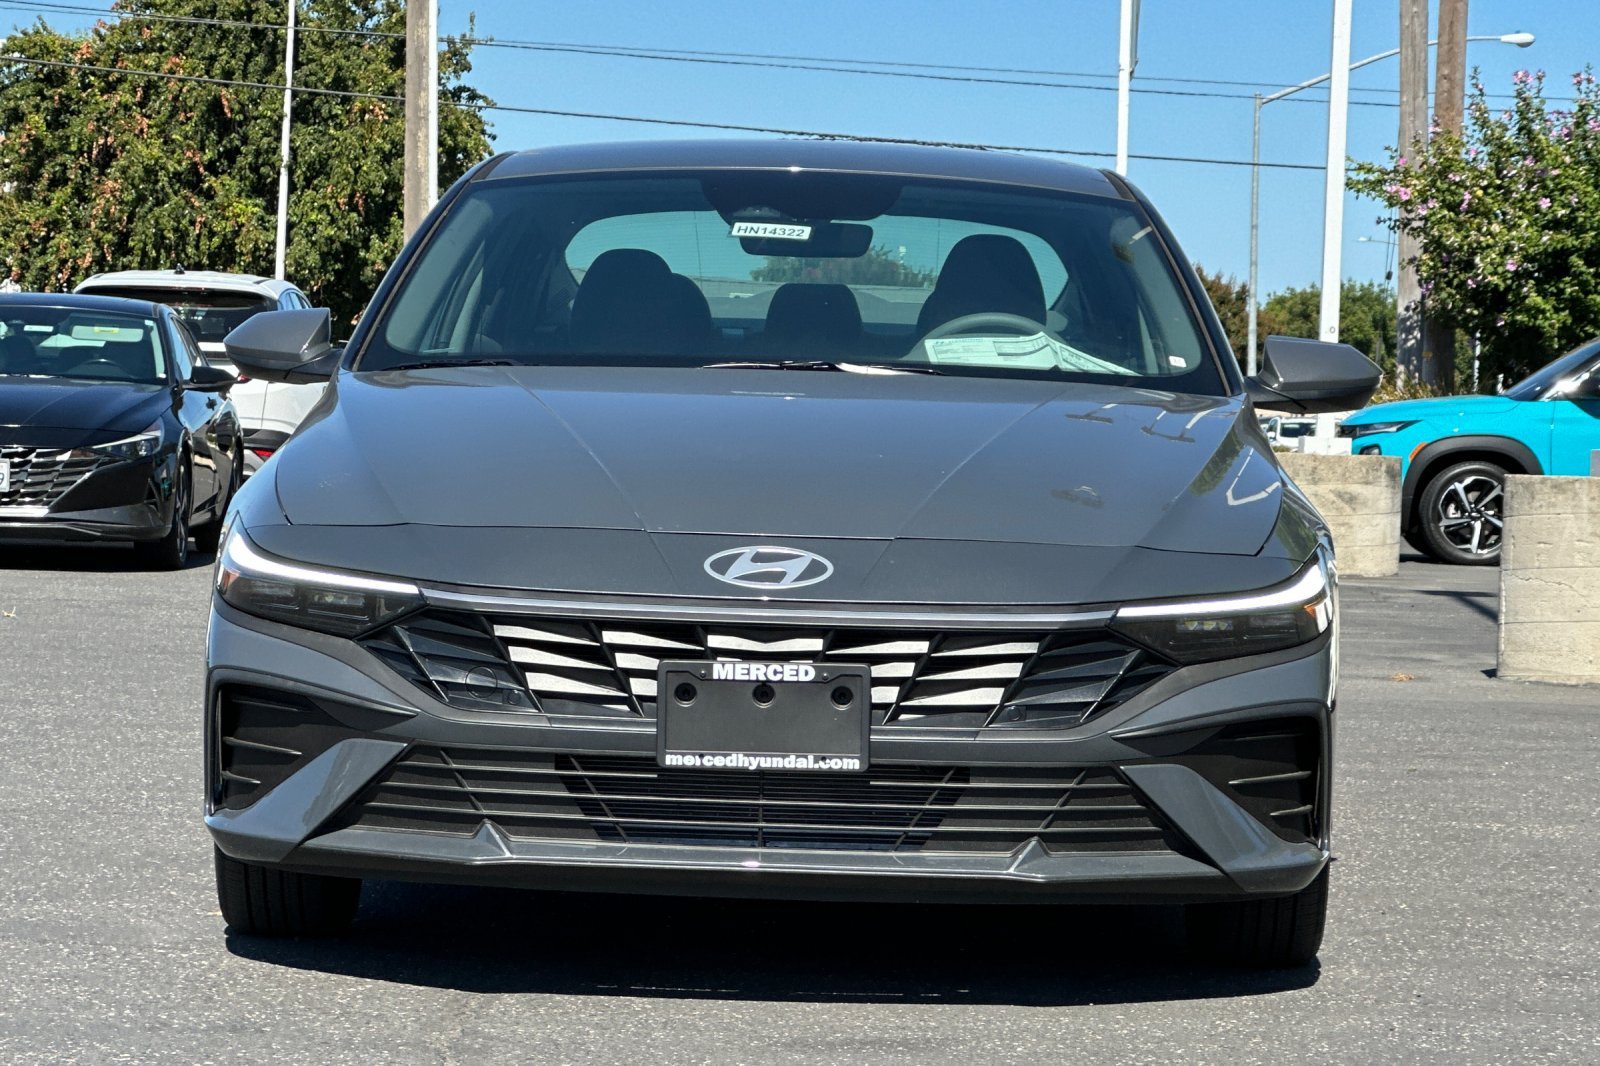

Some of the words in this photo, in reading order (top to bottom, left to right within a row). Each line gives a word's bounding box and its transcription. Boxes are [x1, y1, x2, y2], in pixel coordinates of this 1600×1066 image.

[737, 225, 805, 237] HN14322
[712, 663, 816, 682] MERCED
[665, 753, 860, 770] mercedhyundai.com
